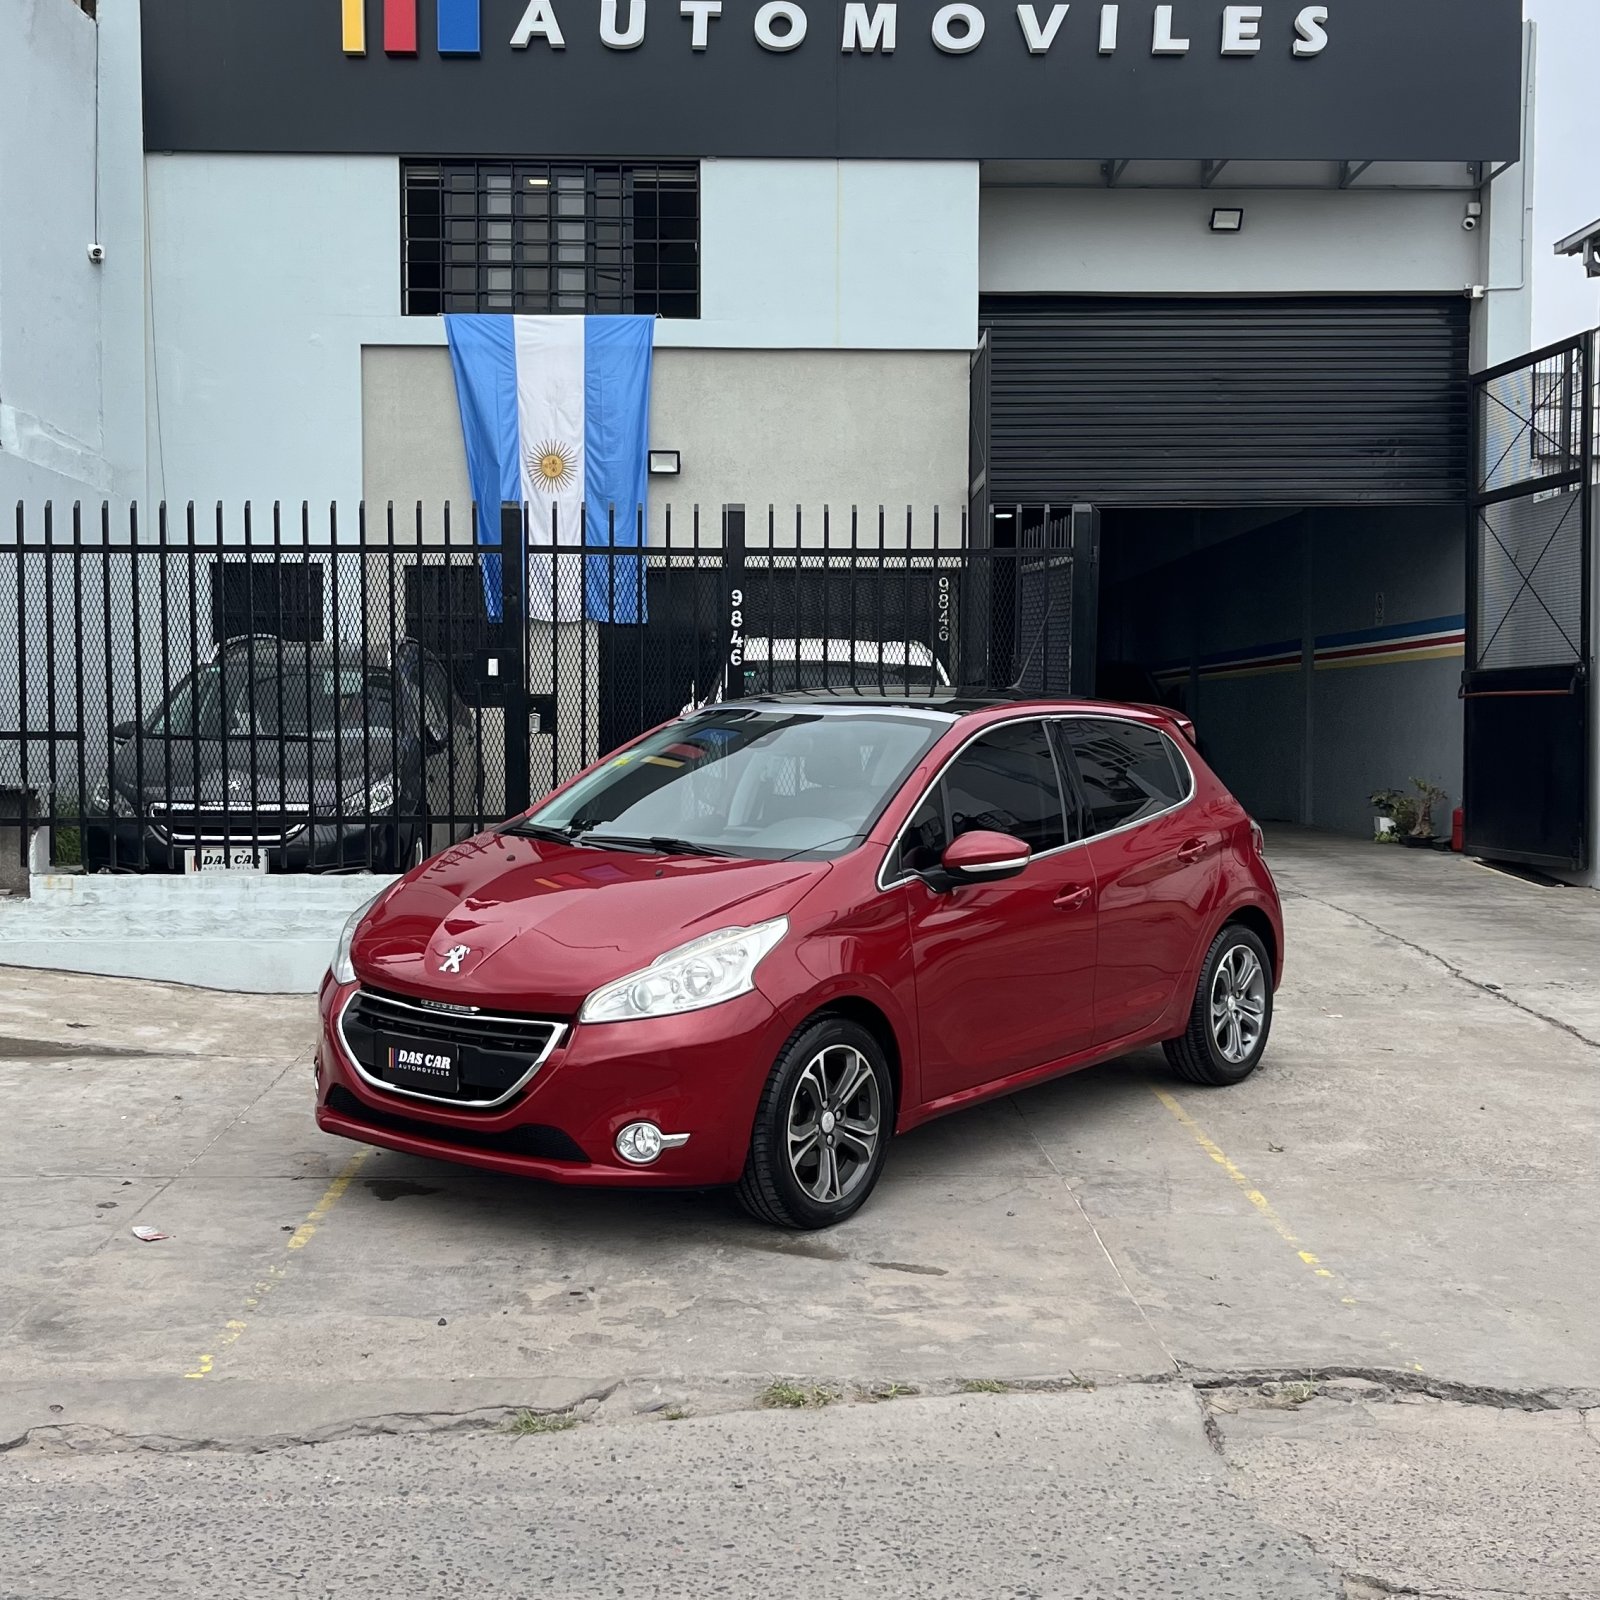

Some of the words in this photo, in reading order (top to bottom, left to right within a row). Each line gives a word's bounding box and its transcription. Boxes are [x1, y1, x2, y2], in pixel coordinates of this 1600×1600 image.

[509, 0, 1329, 57] AUTOMOVILES
[730, 589, 744, 666] 9846
[938, 577, 949, 641] 9846
[398, 1049, 423, 1065] DAS
[424, 1054, 451, 1070] CAR
[398, 1063, 450, 1077] AUTOMOVILES
